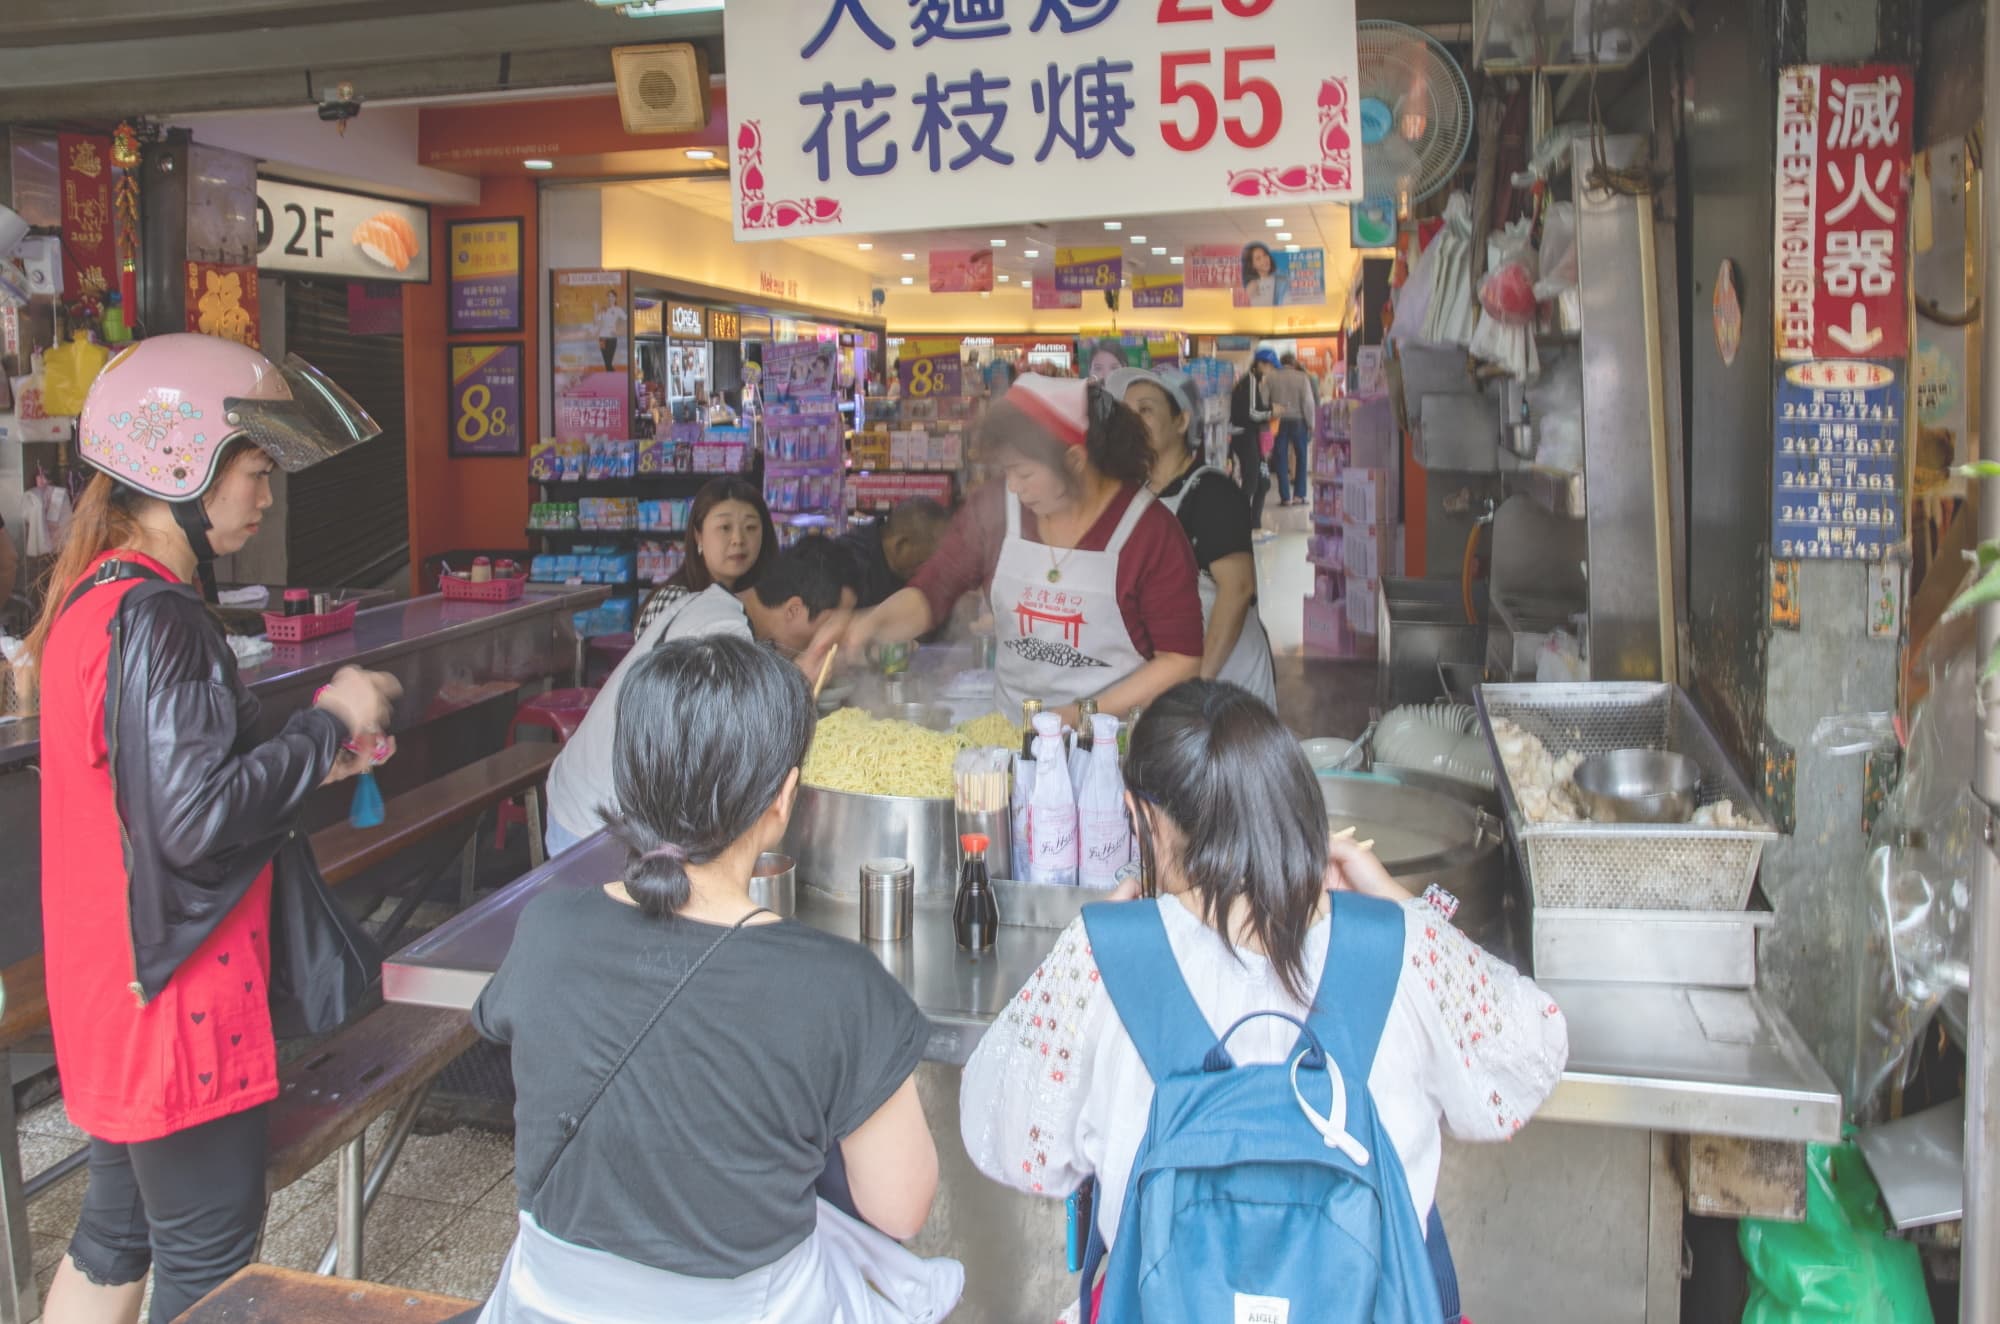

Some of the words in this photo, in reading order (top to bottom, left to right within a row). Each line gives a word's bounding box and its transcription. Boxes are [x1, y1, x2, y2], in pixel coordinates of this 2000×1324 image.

[799, 55, 1136, 182] 花枝焿
[1158, 45, 1284, 152] 55
[284, 202, 334, 258] 2F
[1824, 75, 1902, 297] 滅火器
[713, 312, 738, 338] 1028
